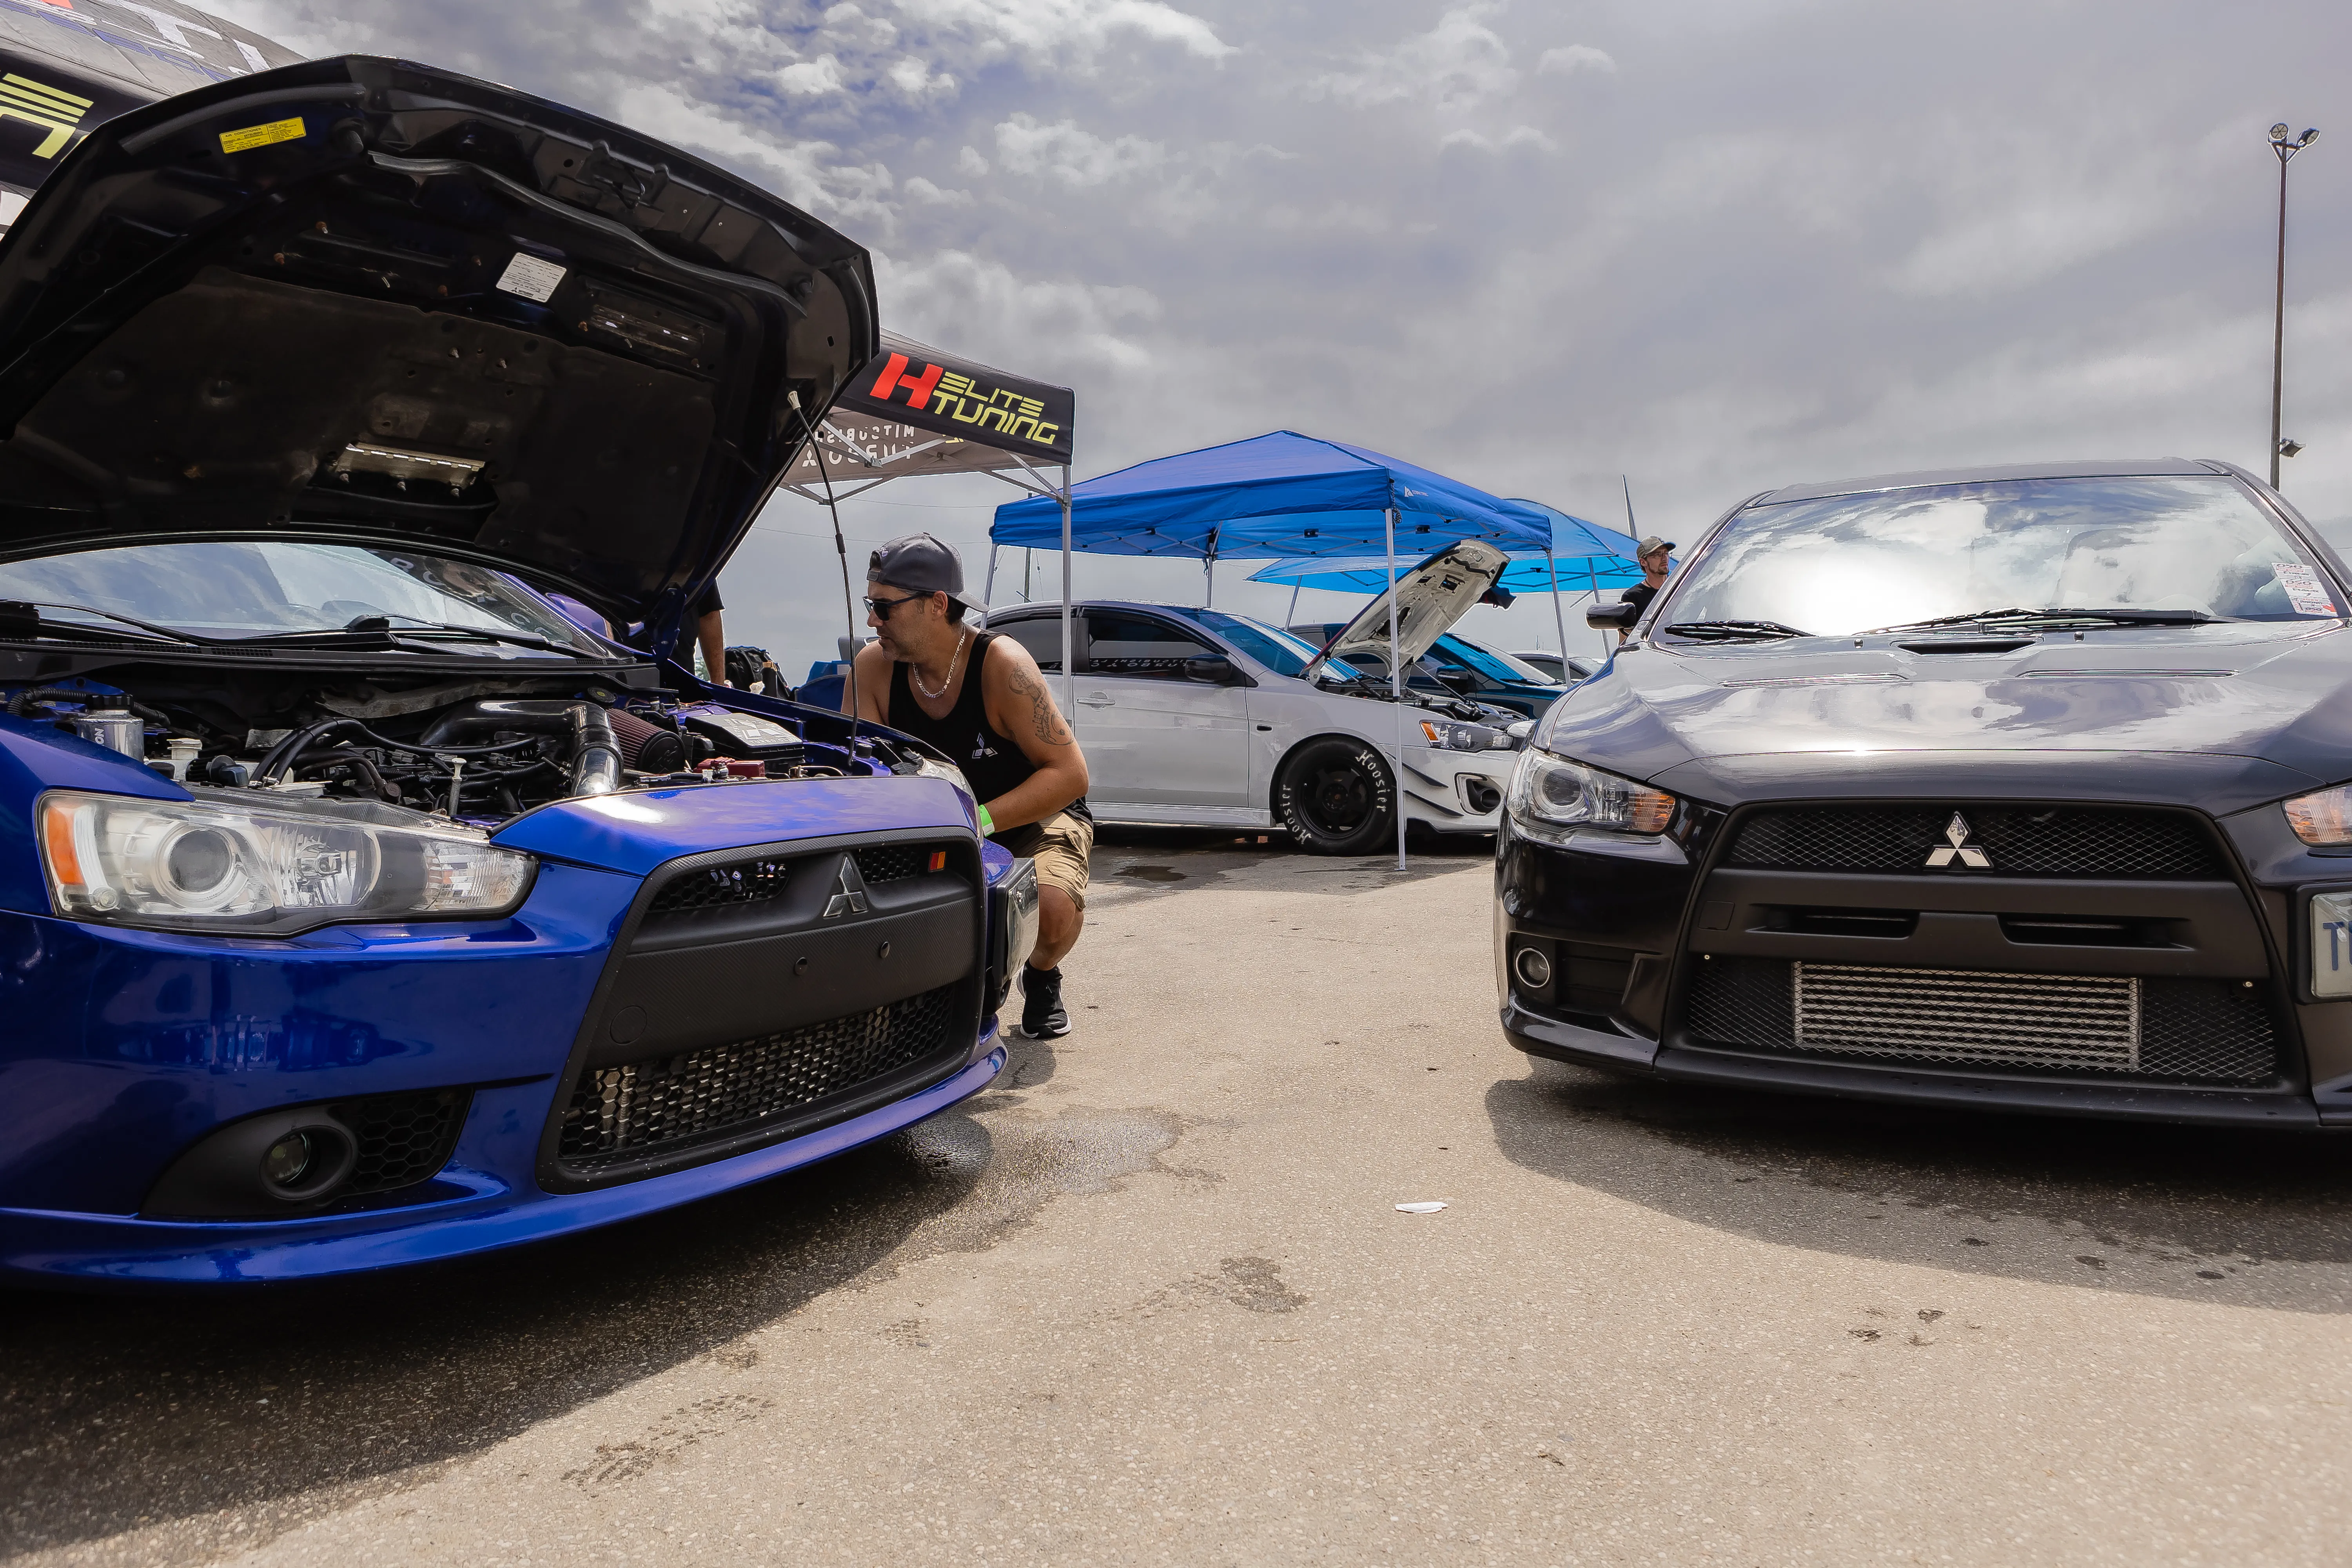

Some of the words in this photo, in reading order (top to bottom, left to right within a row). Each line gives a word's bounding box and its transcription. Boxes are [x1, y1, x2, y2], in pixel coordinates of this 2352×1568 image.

[234, 127, 261, 136] CONDITIONER
[933, 390, 1058, 445] TUNING
[938, 372, 1044, 417] ELITE
[1355, 750, 1390, 812] Hoosier
[1280, 784, 1312, 844] Hoosier
